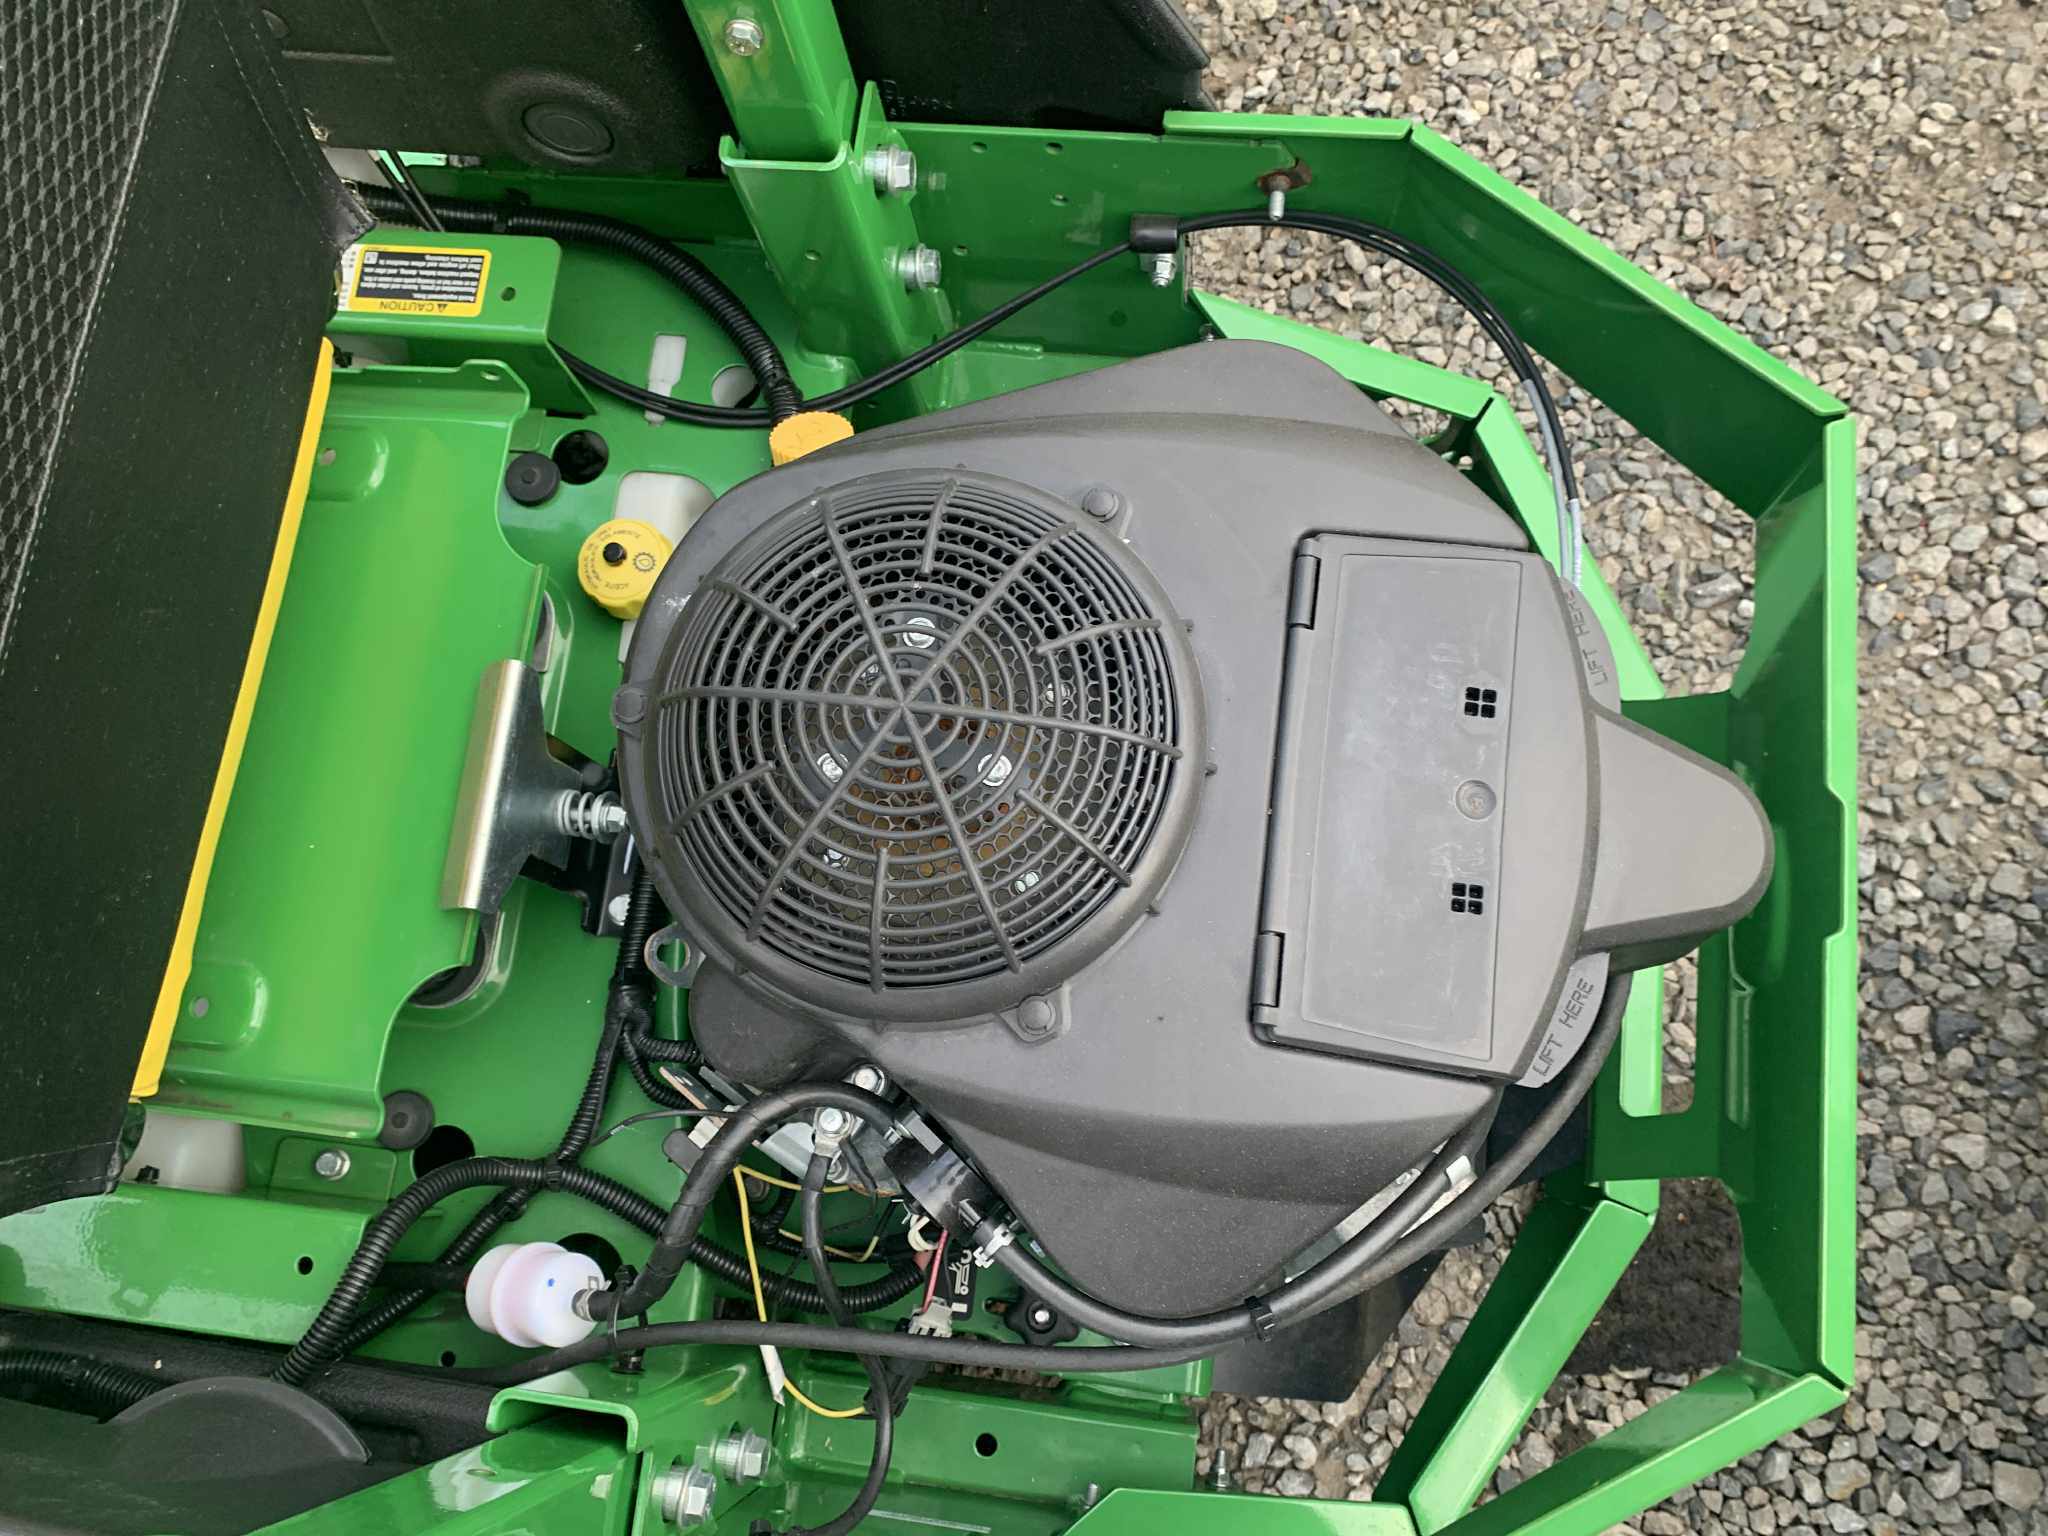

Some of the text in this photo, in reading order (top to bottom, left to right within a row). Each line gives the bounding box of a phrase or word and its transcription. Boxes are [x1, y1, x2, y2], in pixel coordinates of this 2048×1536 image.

[379, 301, 434, 312] CAUTION
[1582, 649, 1608, 686] LIFT
[1532, 977, 1594, 1077] LIFT HERE
